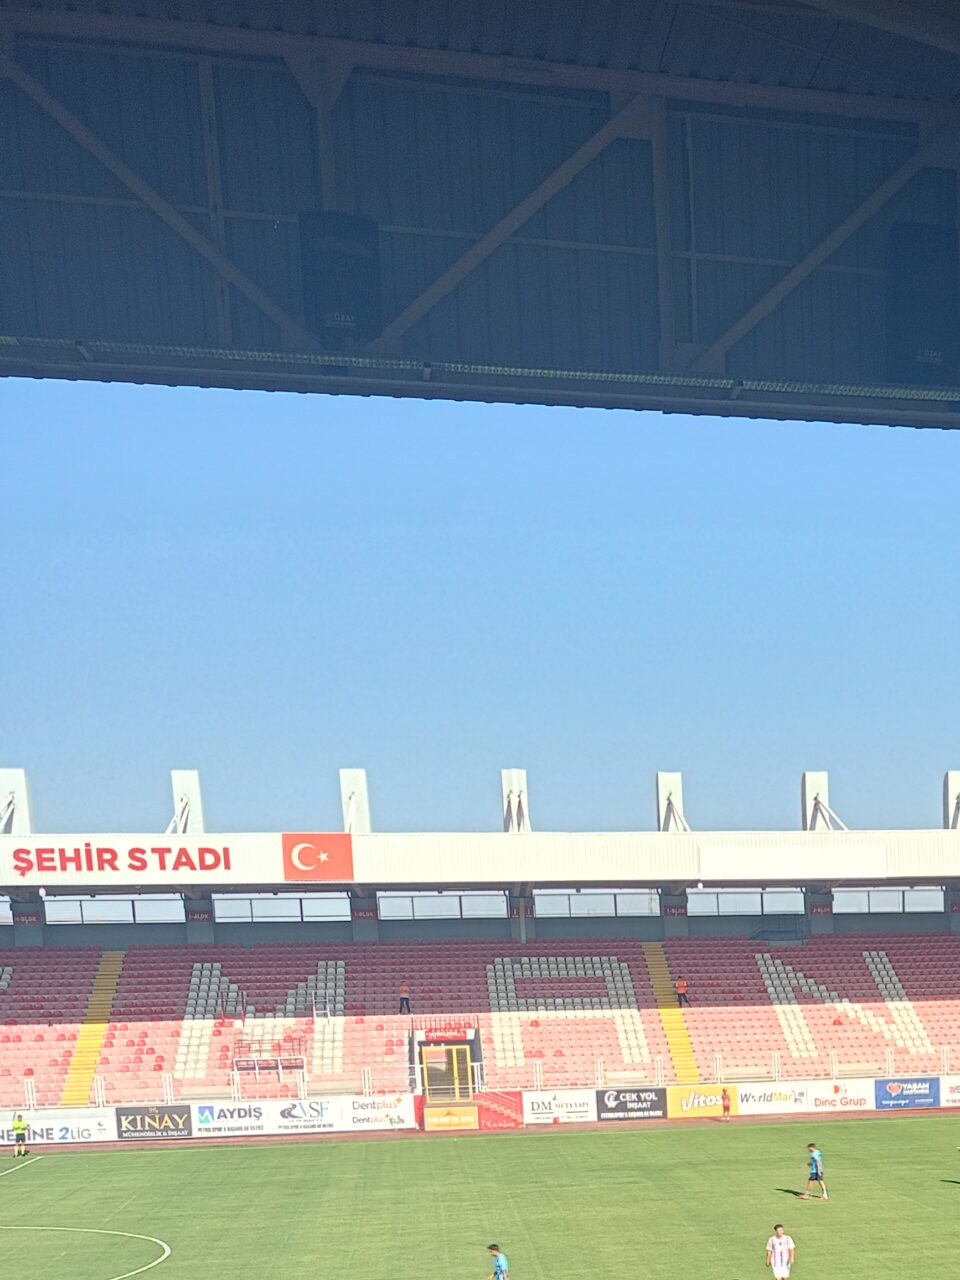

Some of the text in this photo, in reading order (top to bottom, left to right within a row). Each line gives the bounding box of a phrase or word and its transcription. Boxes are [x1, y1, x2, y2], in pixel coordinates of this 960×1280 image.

[12, 842, 232, 877] ŞEHİR STADI
[640, 1091, 658, 1101] YOL
[814, 1096, 867, 1107] Dinç Grup
[352, 1099, 398, 1111] Dentplus
[530, 1101, 552, 1112] DM
[216, 1104, 263, 1121] AYDİŞ
[120, 1113, 188, 1131] KINAY
[58, 1126, 70, 1141] 2
[71, 1127, 92, 1140] LİG
